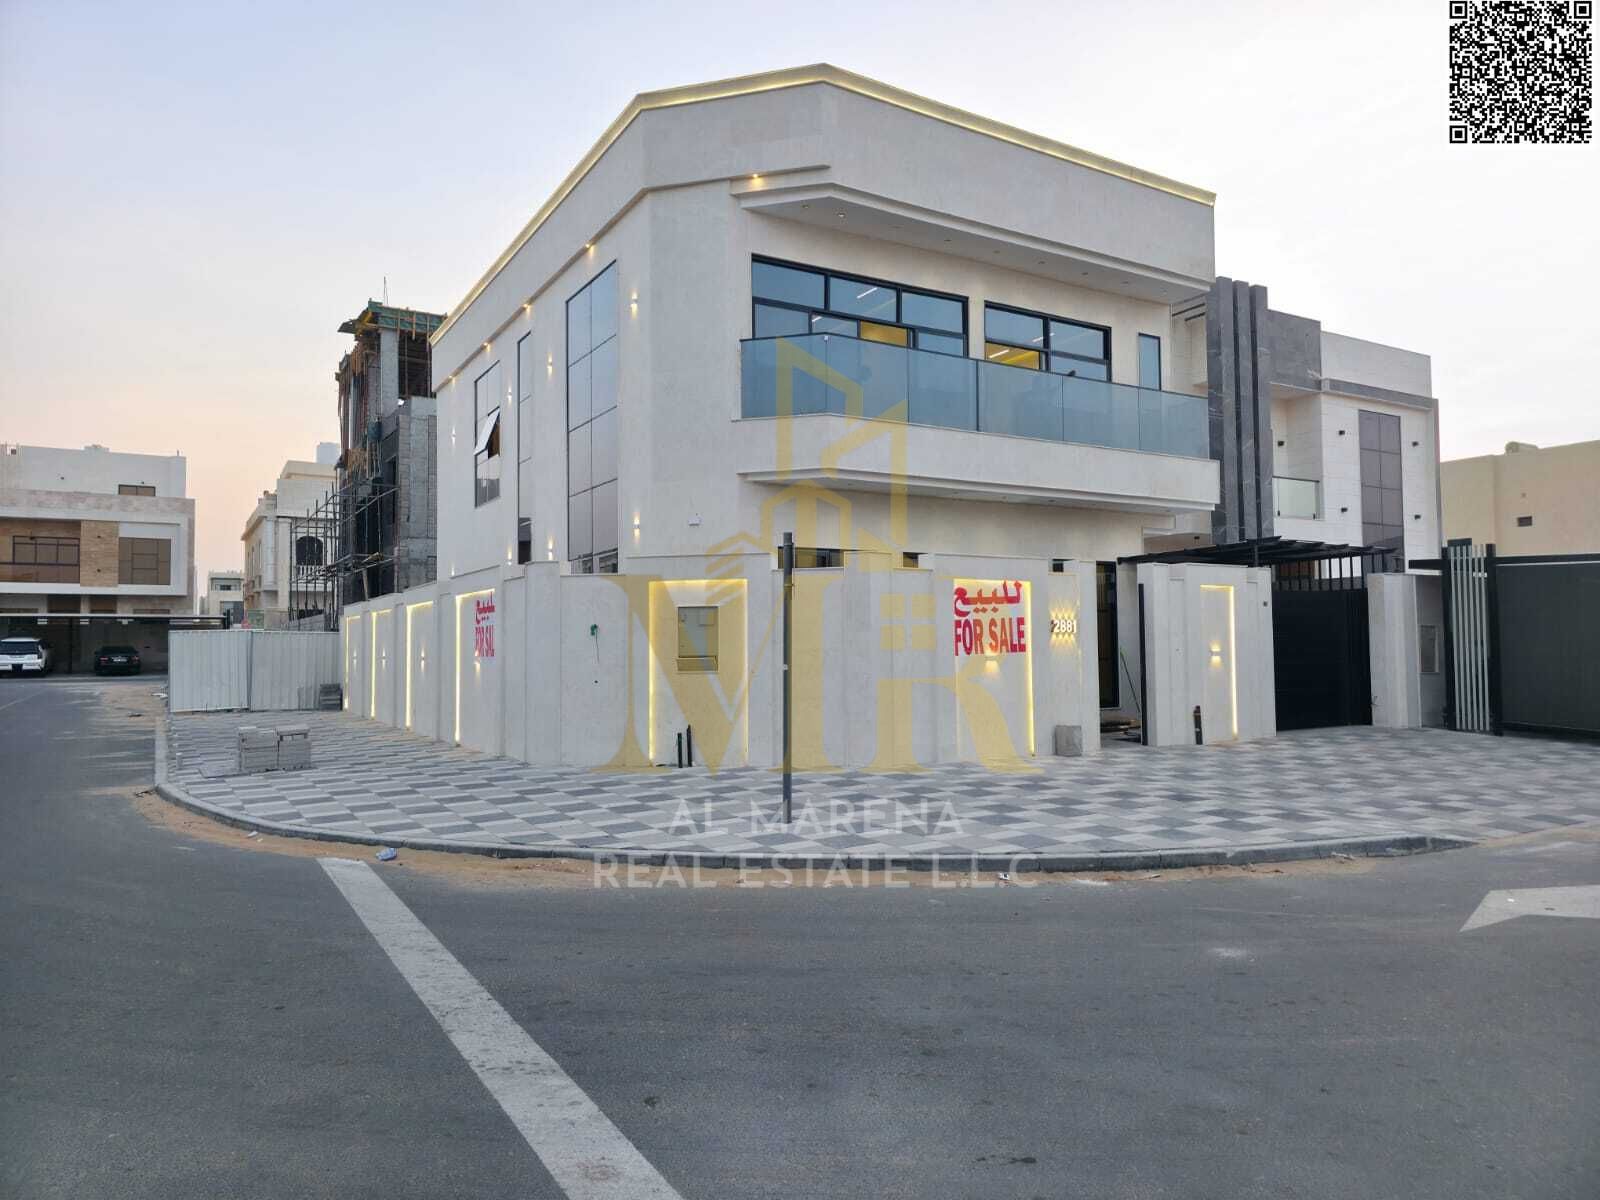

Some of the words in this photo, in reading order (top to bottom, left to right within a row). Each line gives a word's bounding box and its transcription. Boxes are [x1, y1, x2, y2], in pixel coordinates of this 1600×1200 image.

[954, 580, 1022, 617] للبيع
[486, 624, 495, 656] SAL
[954, 619, 984, 656] FOR
[988, 616, 1026, 654] SALE
[1052, 619, 1077, 633] 2881
